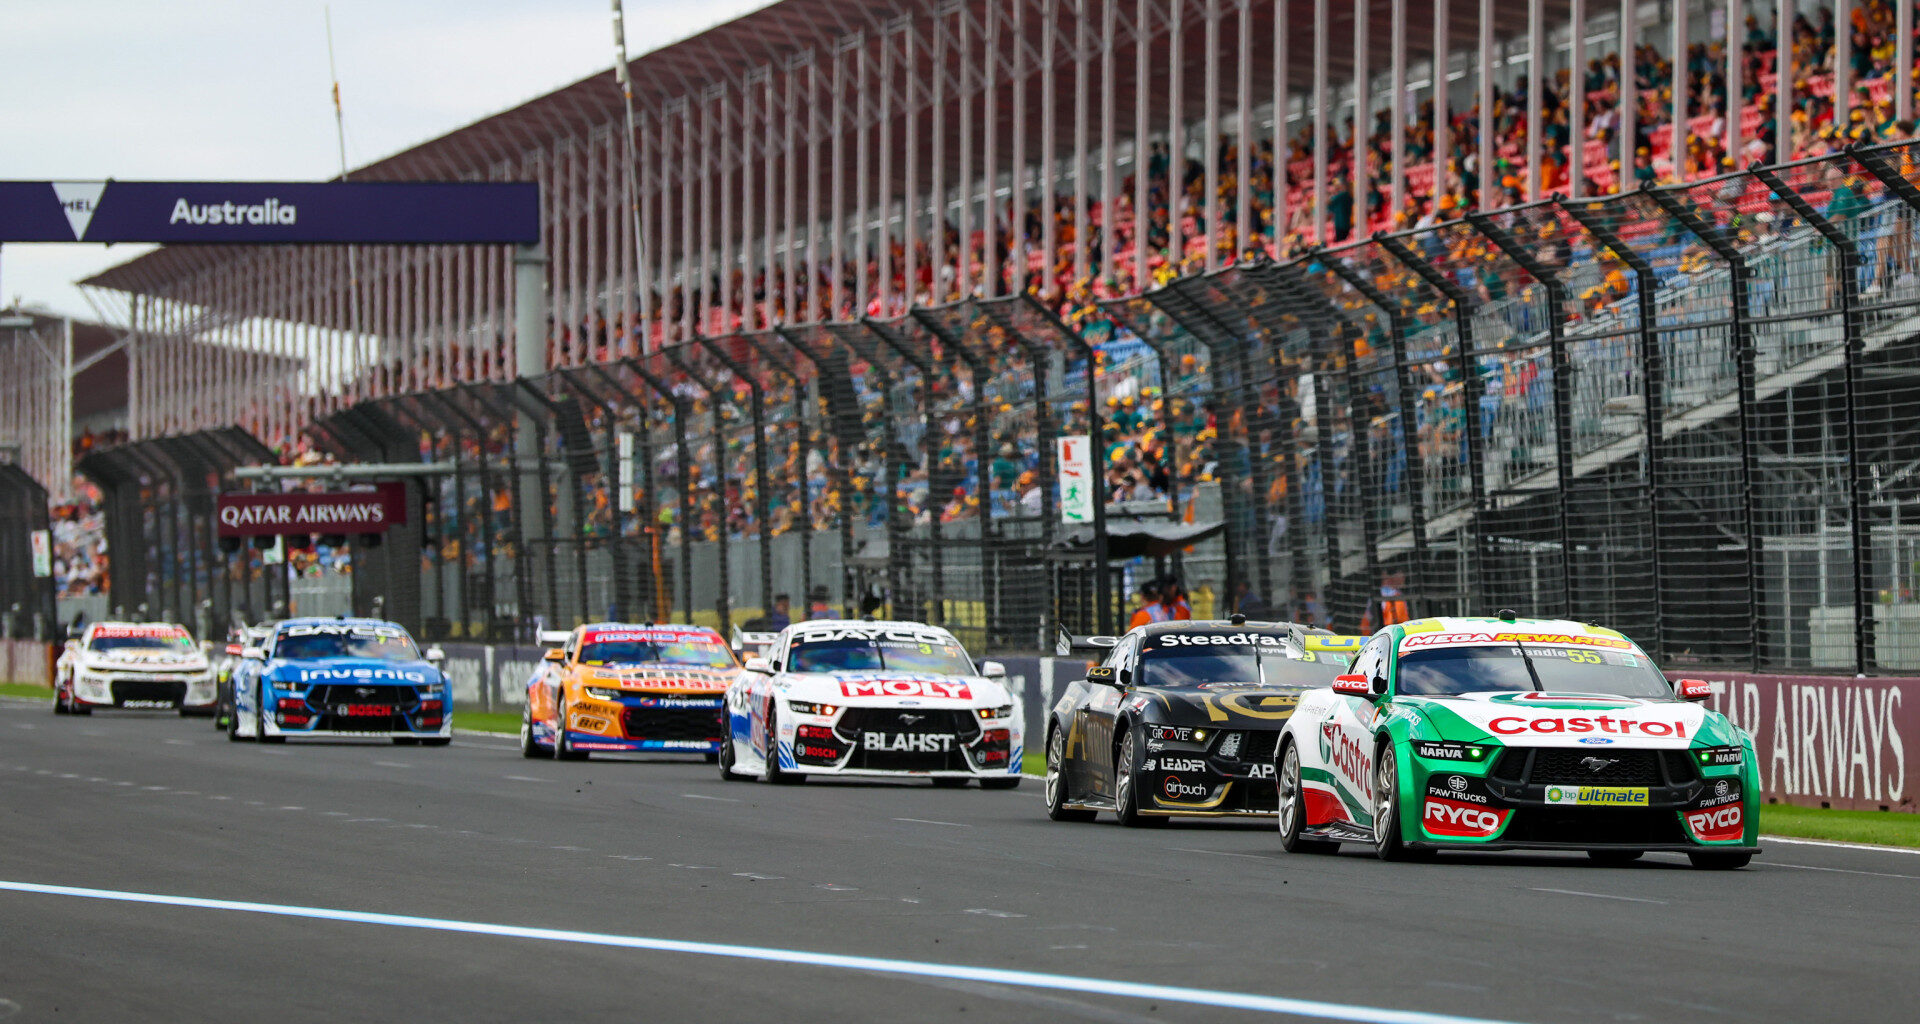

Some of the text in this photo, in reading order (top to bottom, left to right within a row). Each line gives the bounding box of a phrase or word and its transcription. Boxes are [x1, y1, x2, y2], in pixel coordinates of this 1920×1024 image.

[169, 198, 297, 225] Australia
[221, 503, 384, 527] QATAR AIRWAYS
[803, 630, 946, 646] DAYCO
[1159, 633, 1290, 647] Steadfas
[918, 643, 933, 655] 3
[1567, 649, 1602, 664] 55
[847, 680, 967, 698] MOLY
[1335, 680, 1369, 689] RYCO
[348, 704, 392, 716] BOSCH
[1488, 715, 1686, 738] Castrol
[864, 732, 955, 752] BLAHST
[1152, 729, 1189, 741] GROVE
[1770, 681, 1905, 802] AIRWAYS
[806, 746, 837, 759] BOSCH
[1420, 746, 1463, 758] NARVA
[1160, 758, 1207, 773] LEADER
[1332, 723, 1373, 801] Castro
[1166, 781, 1207, 796] airtouch
[1429, 786, 1487, 803] FAW TRUCKS
[1564, 788, 1646, 803] bp ultimate
[1700, 792, 1740, 808] FAW TRUCKS
[1425, 801, 1500, 831] RYCO
[1688, 805, 1741, 834] RYCO
